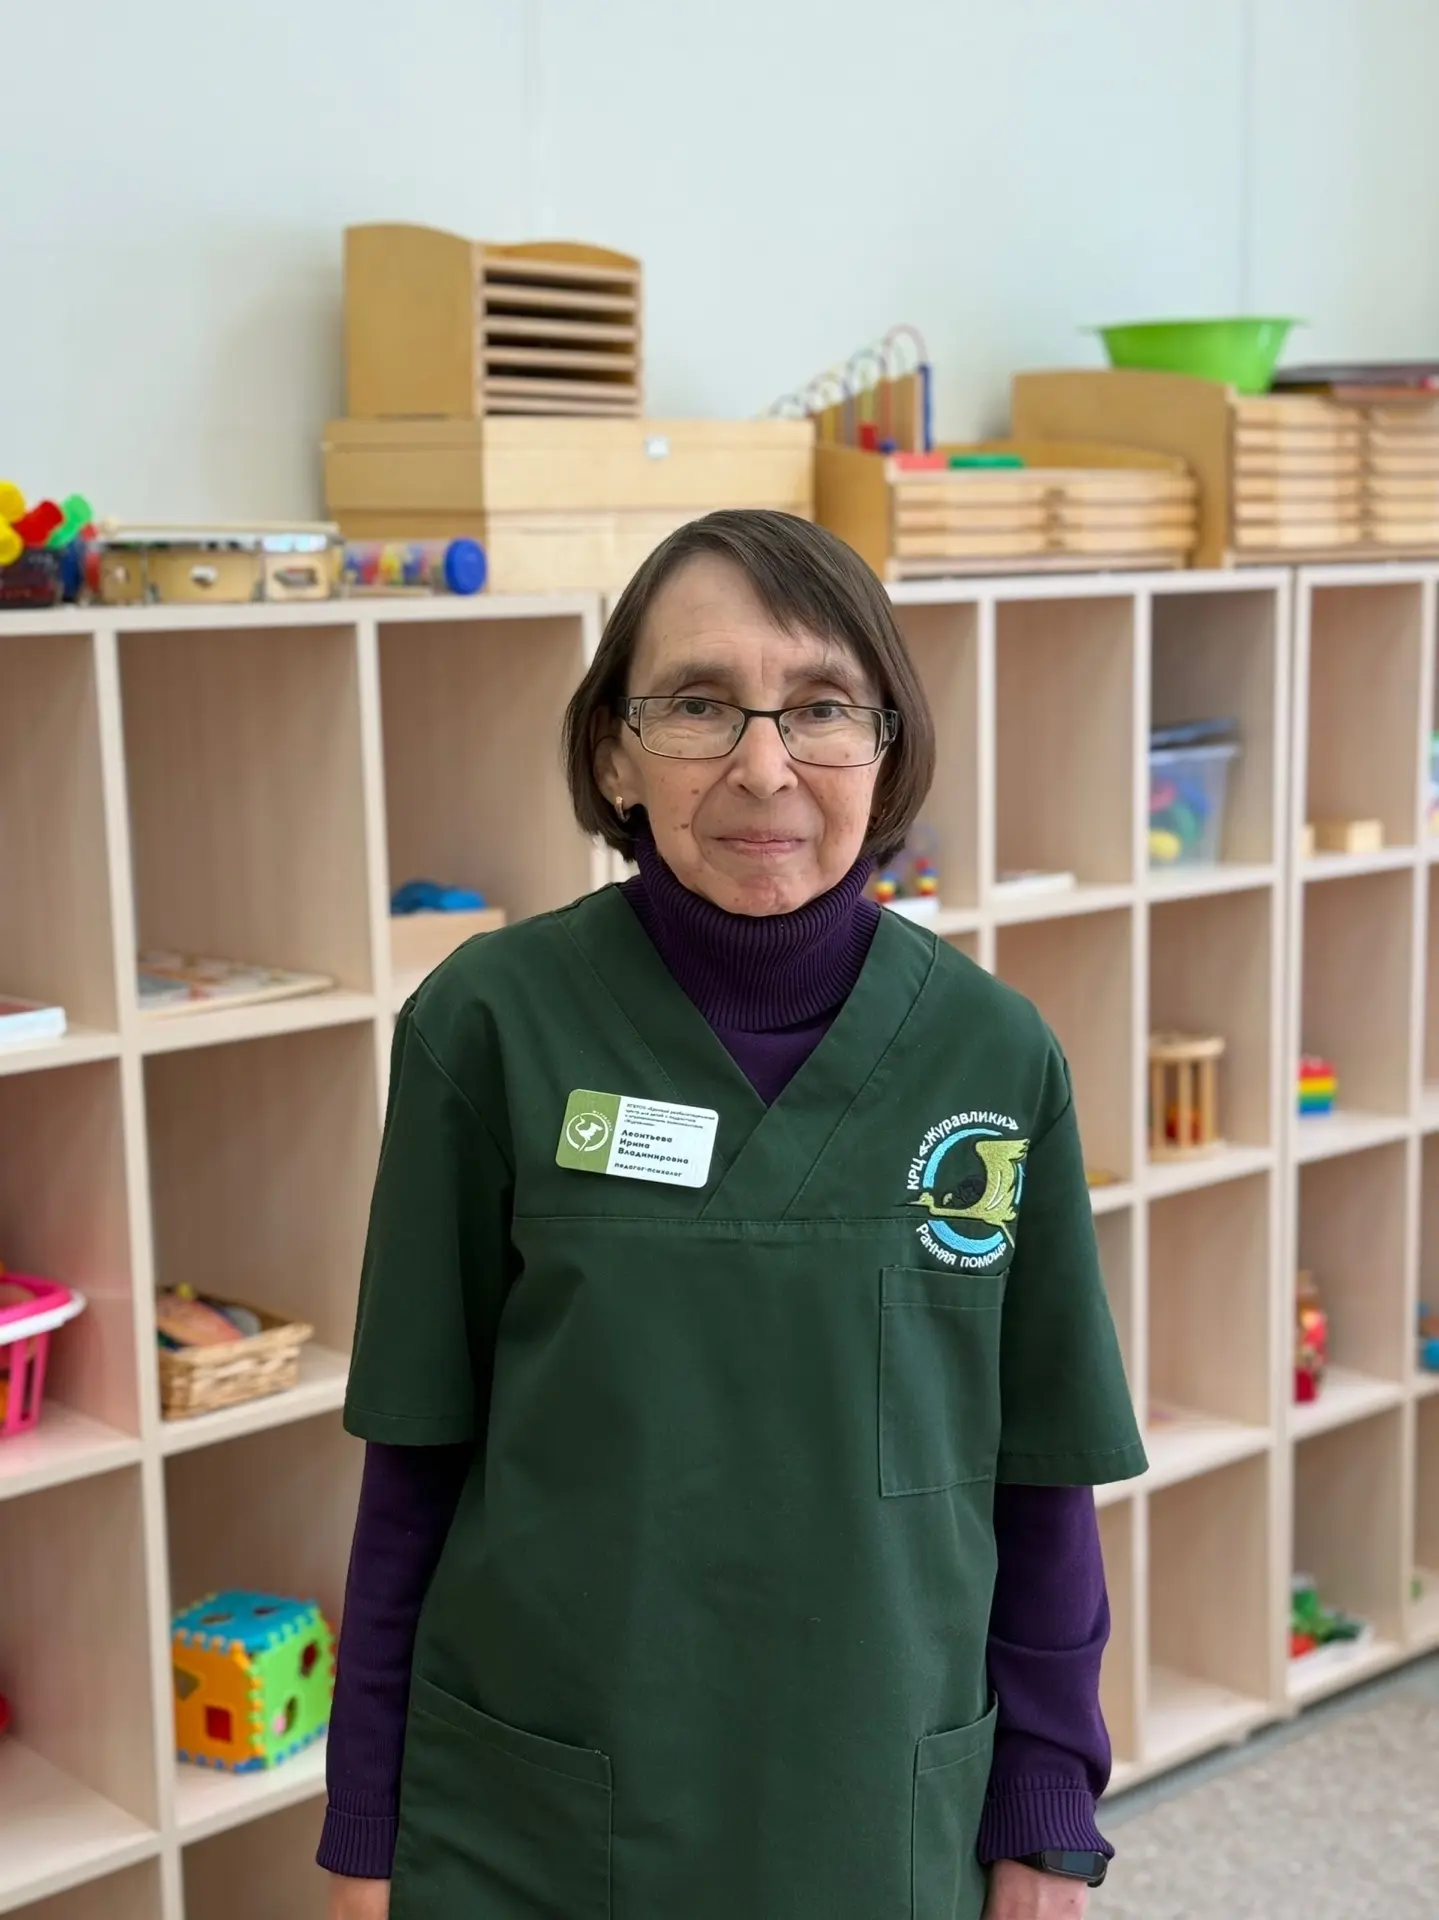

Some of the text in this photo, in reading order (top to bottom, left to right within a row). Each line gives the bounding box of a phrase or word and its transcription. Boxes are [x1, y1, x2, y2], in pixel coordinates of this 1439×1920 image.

[619, 1138, 650, 1149] Ирина
[621, 1129, 673, 1143] Леонтьева
[618, 1147, 689, 1164] Владимировна
[907, 1111, 1019, 1190] КРЦ «Журавлики»
[614, 1162, 683, 1177] педагог-психолог
[916, 1223, 1007, 1268] Ранняя помощь
